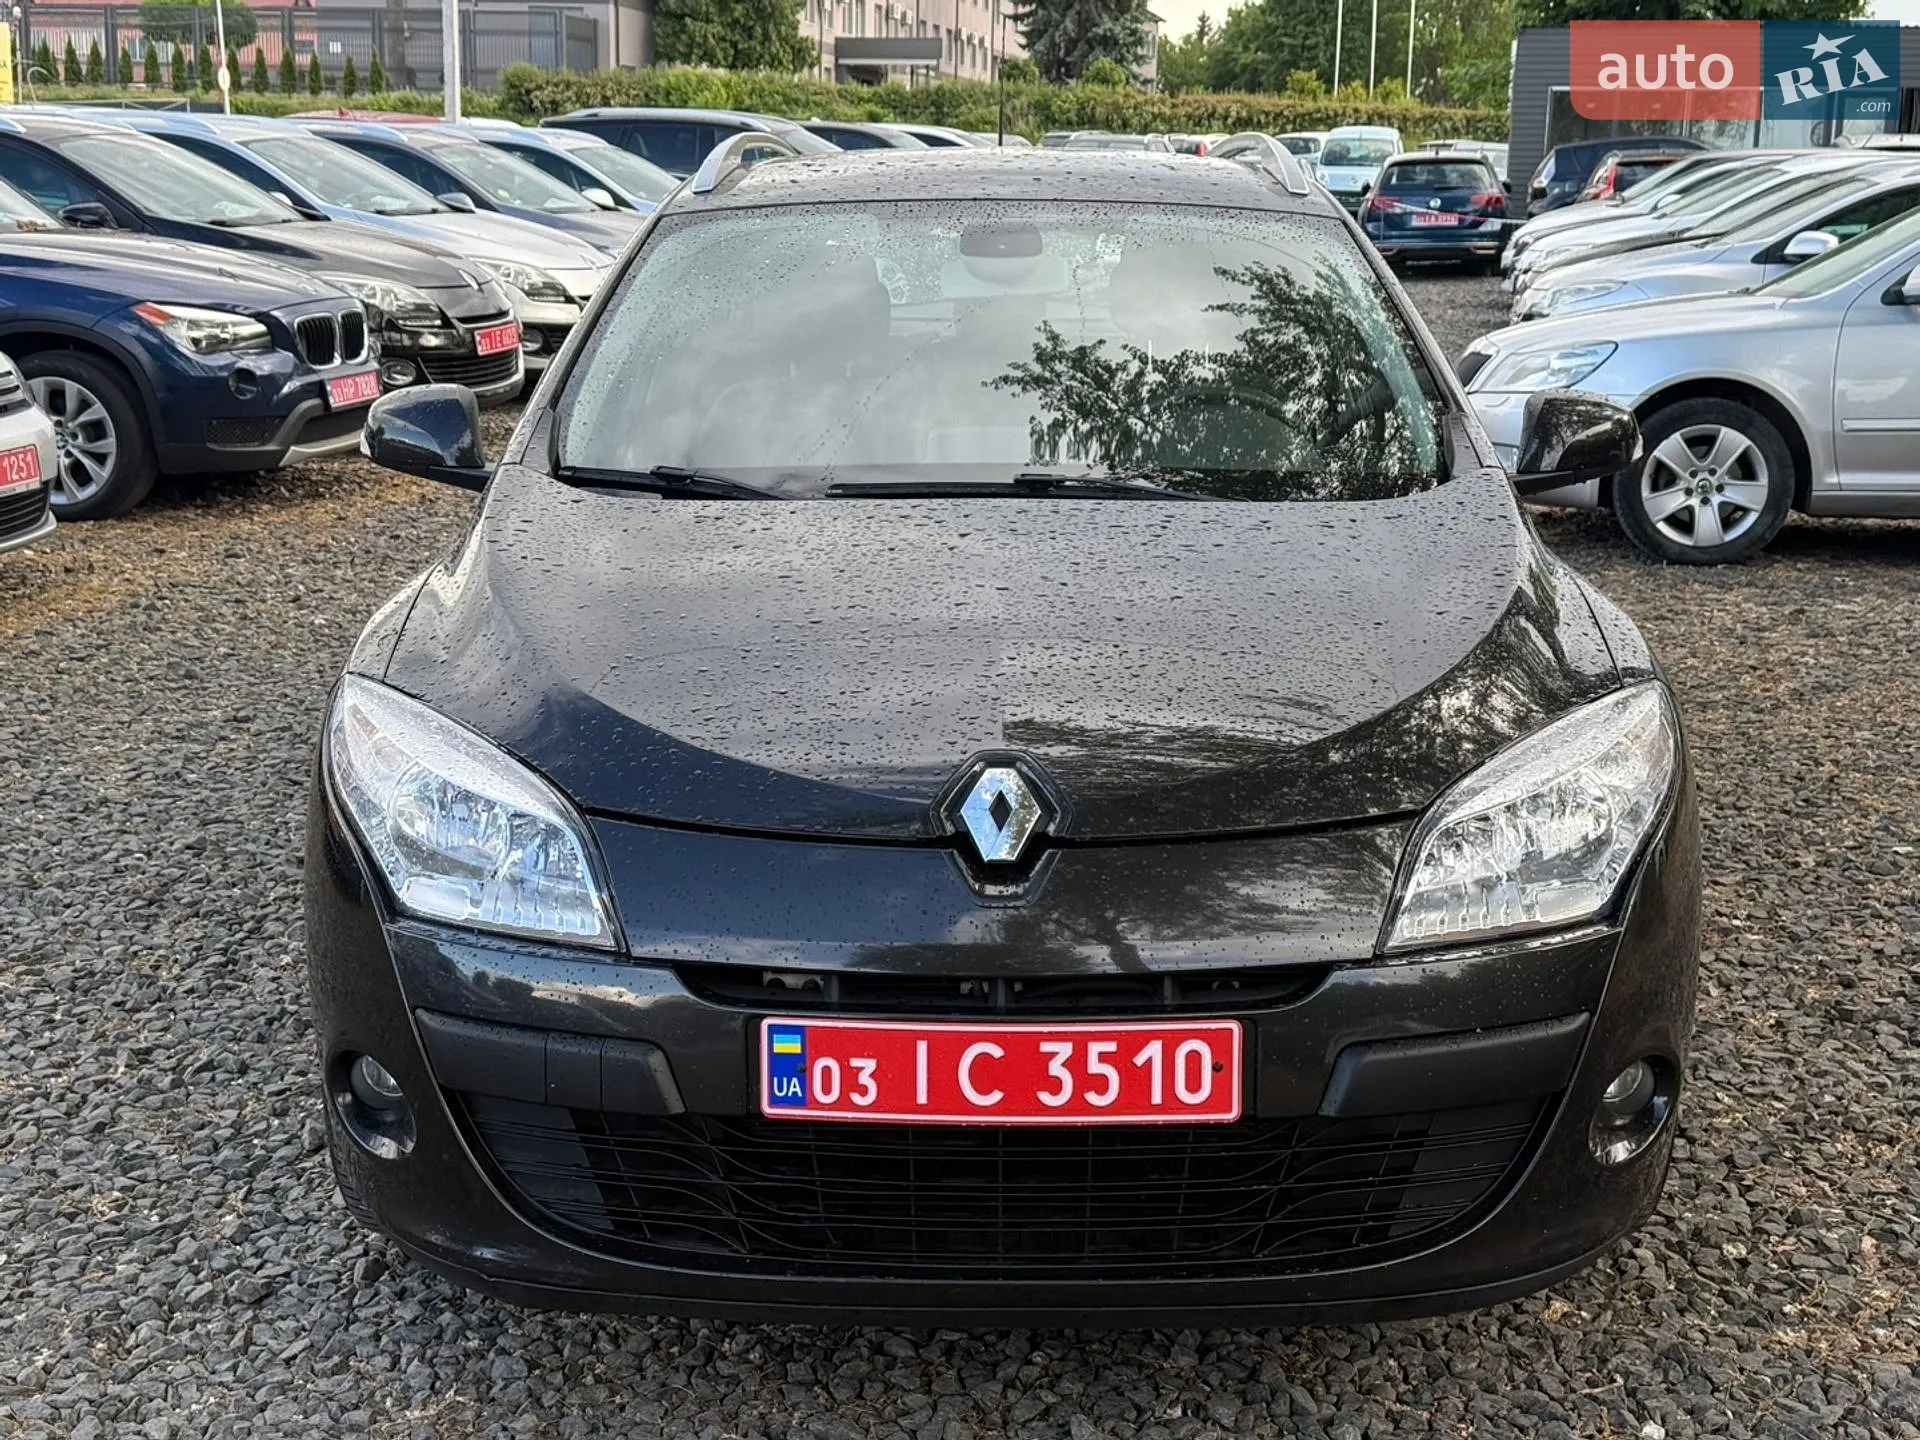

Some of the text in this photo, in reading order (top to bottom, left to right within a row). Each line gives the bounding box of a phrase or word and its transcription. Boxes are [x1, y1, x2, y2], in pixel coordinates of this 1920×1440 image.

[2, 451, 35, 482] 1251
[773, 1076, 803, 1097] UA
[812, 1056, 878, 1107] 03
[1036, 1039, 1212, 1107] 3510
